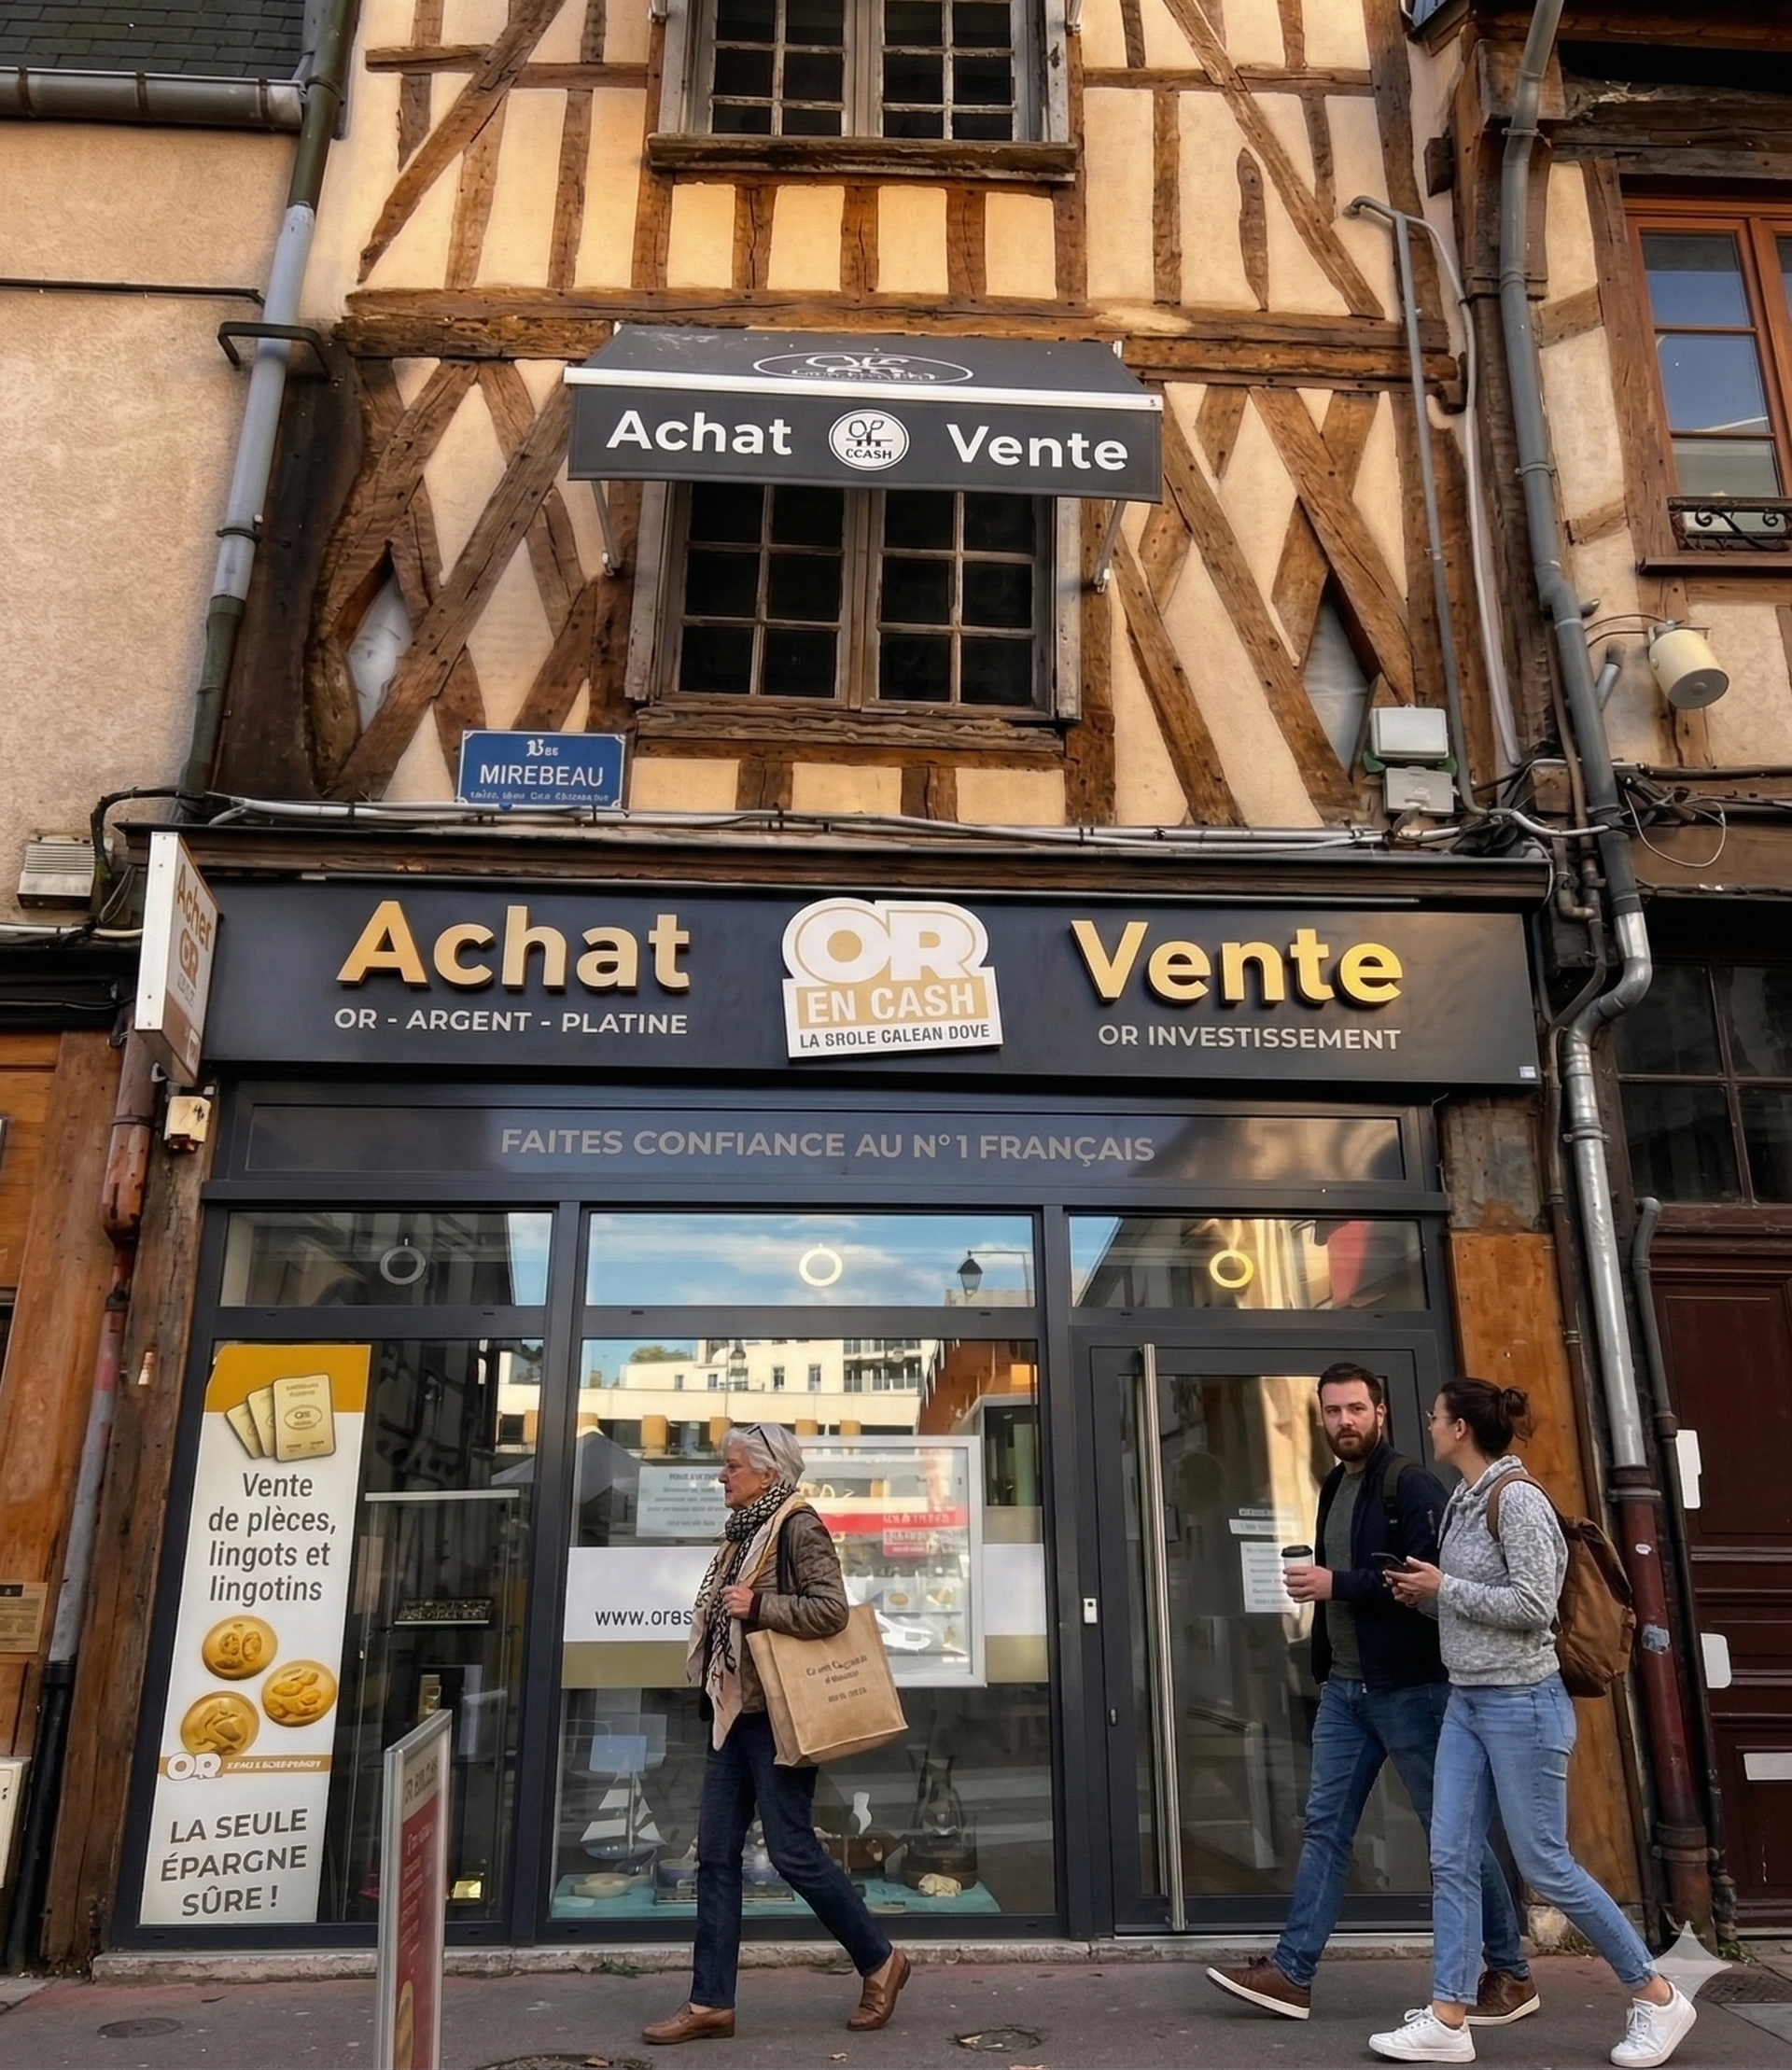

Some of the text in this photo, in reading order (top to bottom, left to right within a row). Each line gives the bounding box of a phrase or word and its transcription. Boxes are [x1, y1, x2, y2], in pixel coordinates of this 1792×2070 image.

[606, 409, 792, 456] Achat
[945, 423, 1129, 471] Vente
[846, 448, 892, 459] CCASH
[480, 764, 603, 787] MIREBEAU
[335, 899, 691, 991] Achat
[794, 906, 977, 984] OR
[1071, 919, 1405, 1010] Vente
[806, 982, 975, 1024] EN CASH
[334, 1007, 378, 1029] OR
[405, 1009, 532, 1032] ARGENT
[562, 1012, 689, 1034] PLATINE
[800, 1033, 819, 1048] LA
[825, 1030, 876, 1047] SROLE
[948, 1024, 990, 1041] DOVE
[1099, 1024, 1402, 1051] OR INVESTISSEMENT
[501, 1128, 623, 1154] FAITES
[633, 1130, 846, 1157] CONFIANCE
[854, 1134, 903, 1158] AU
[980, 1135, 1155, 1168] FRANÇAIS
[242, 1473, 314, 1499] Vente
[208, 1505, 239, 1532] de
[209, 1540, 331, 1573] lingots et
[209, 1574, 323, 1608] lingotins
[167, 1751, 223, 1781] OR
[170, 1808, 308, 1844] LA SEULE
[161, 1844, 308, 1882] ÉPARGNE
[181, 1884, 262, 1917] SÛRE
